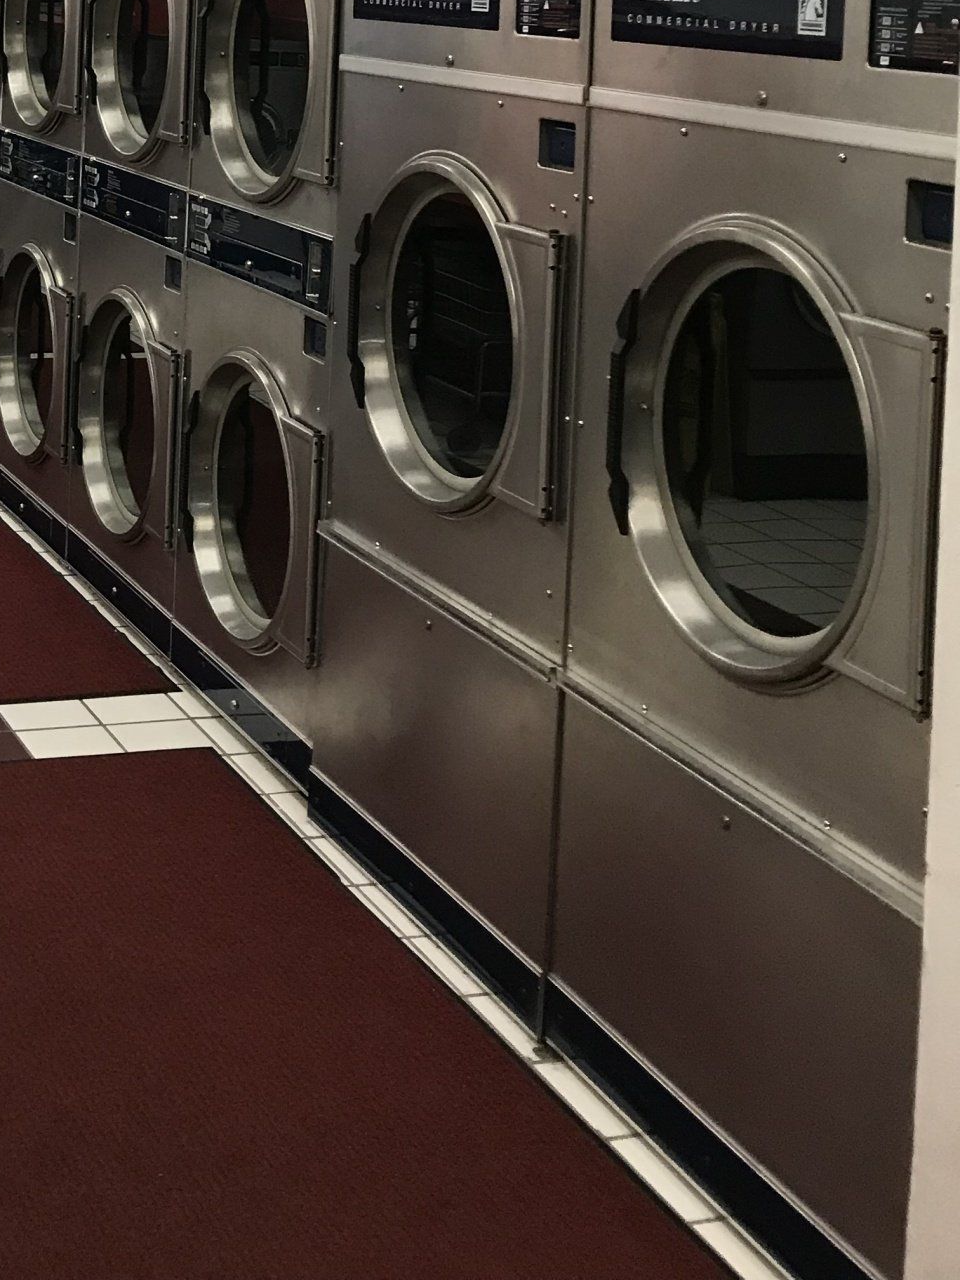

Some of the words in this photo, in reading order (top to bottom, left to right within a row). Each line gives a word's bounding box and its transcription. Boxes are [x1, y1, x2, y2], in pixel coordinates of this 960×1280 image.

[428, 1, 461, 10] DRYER
[627, 13, 719, 29] COMMERCIAL
[729, 21, 780, 33] DRYER
